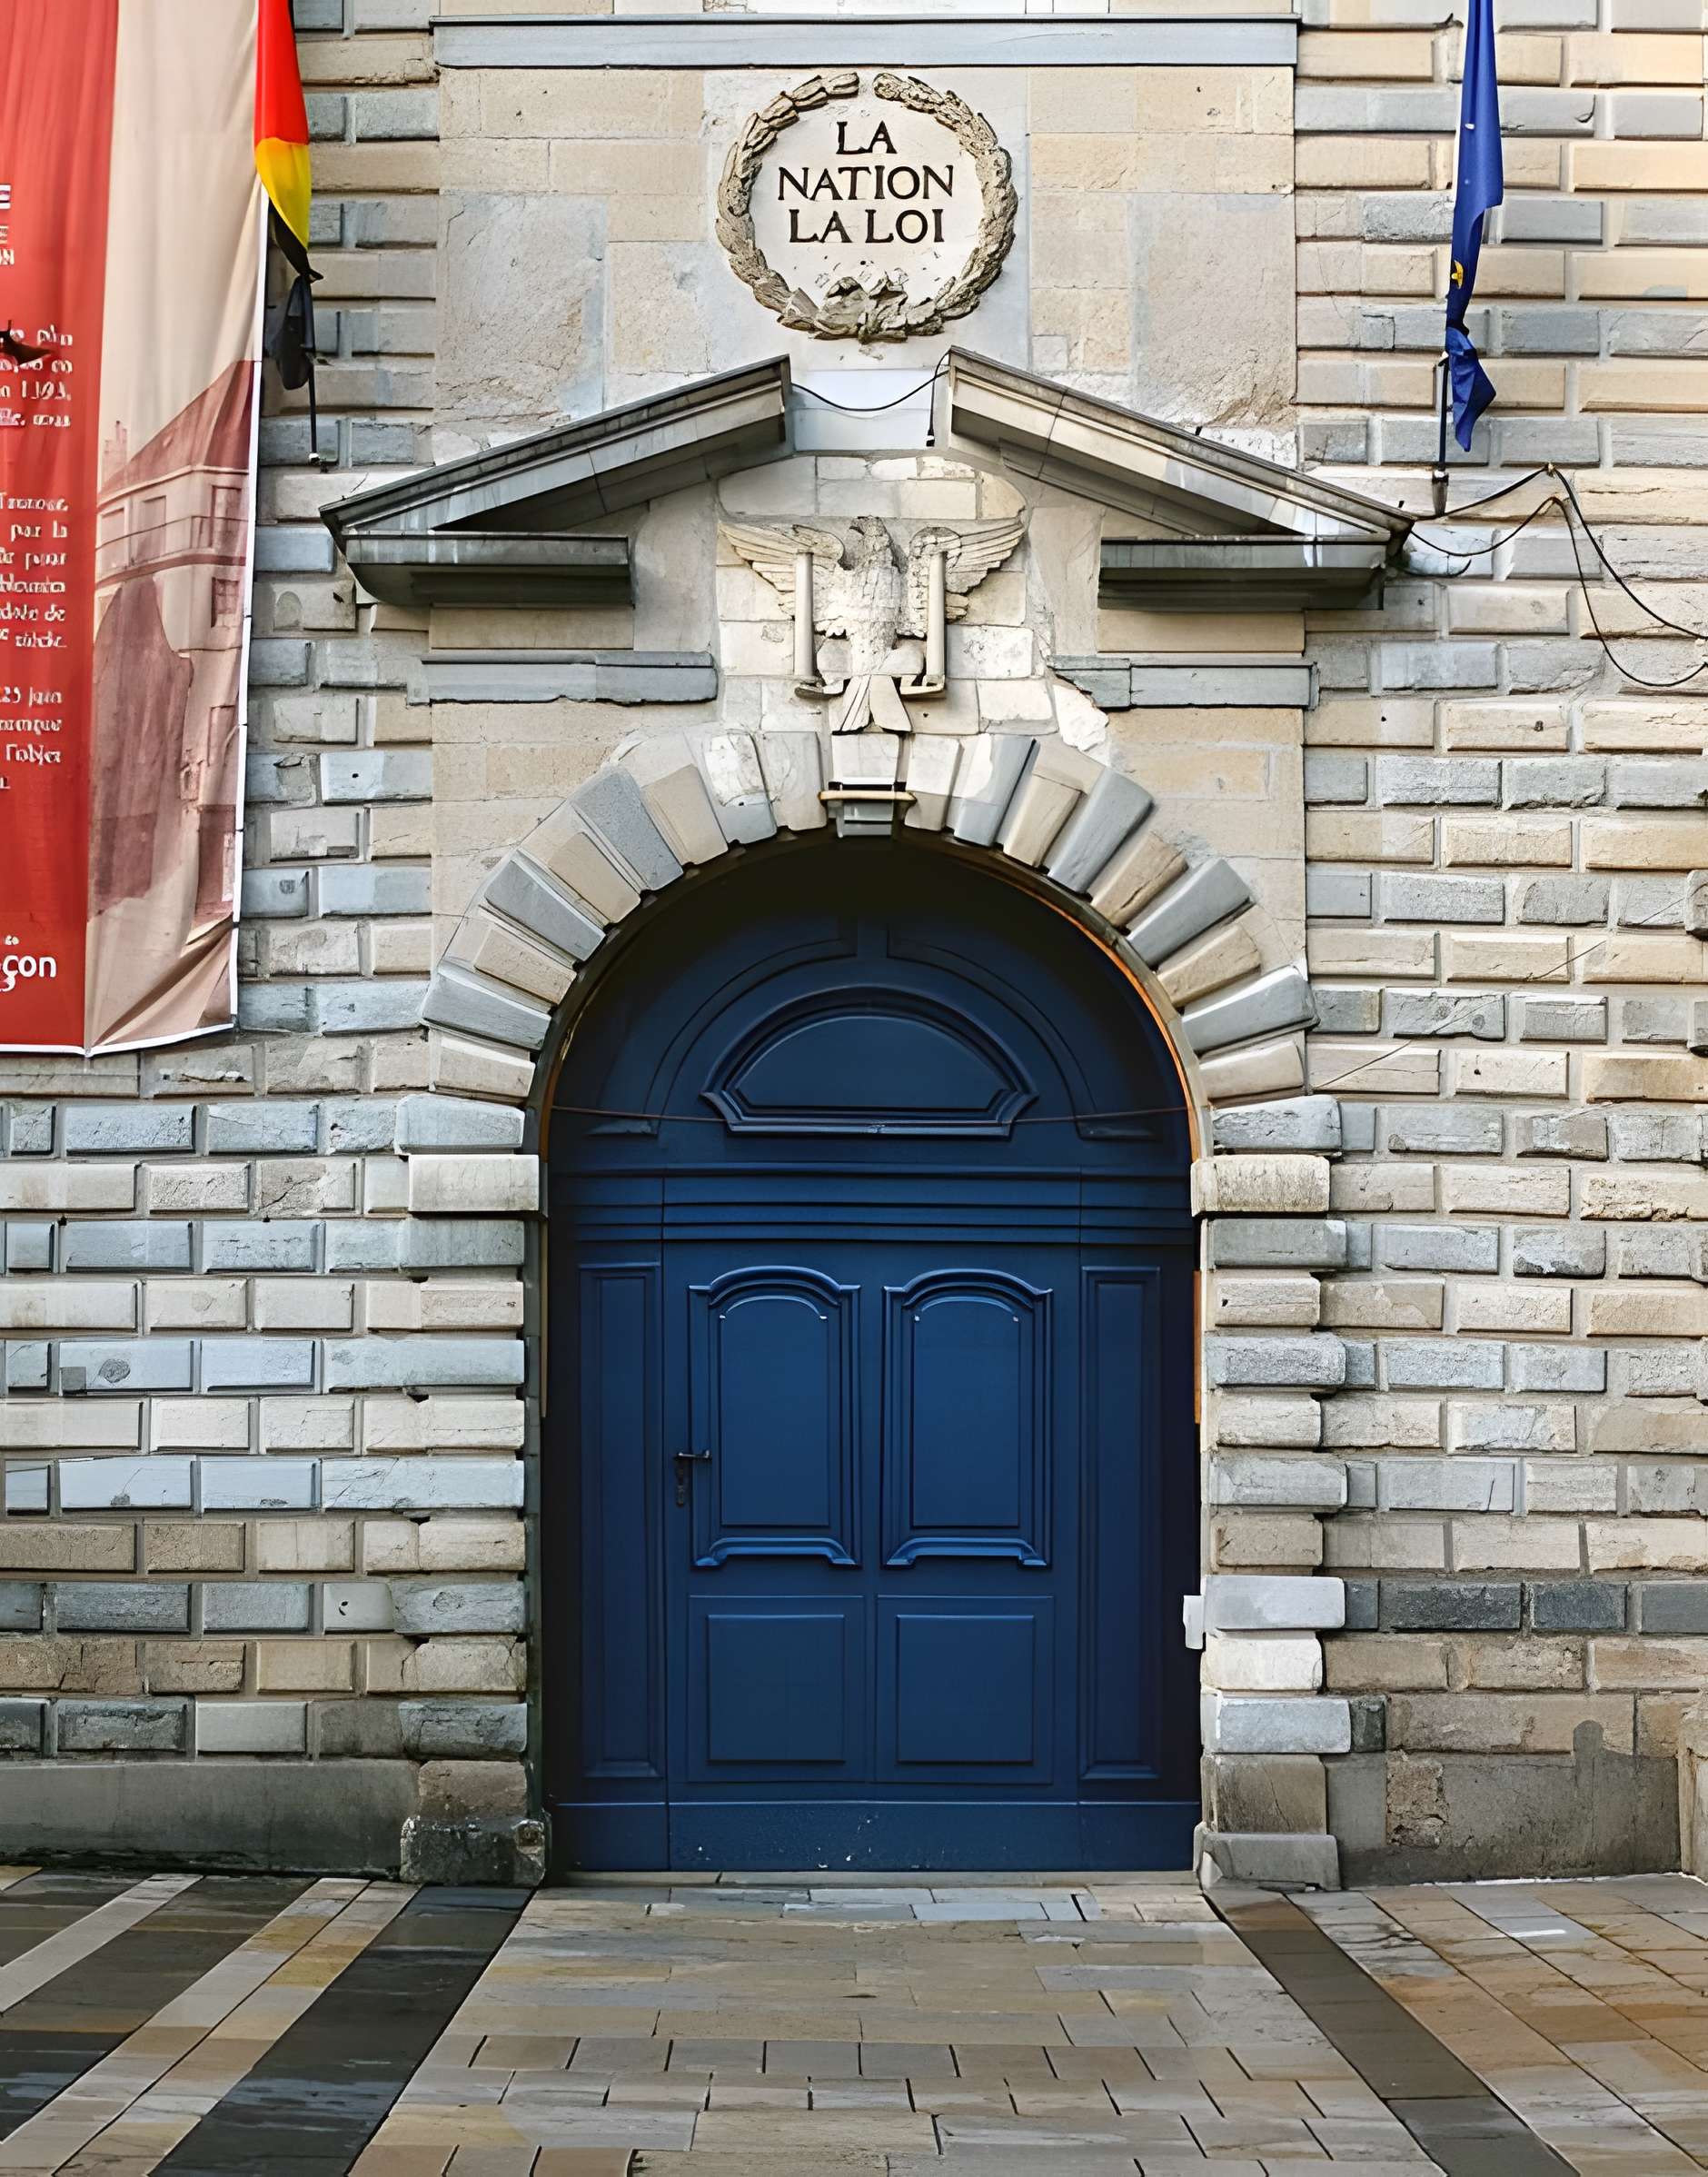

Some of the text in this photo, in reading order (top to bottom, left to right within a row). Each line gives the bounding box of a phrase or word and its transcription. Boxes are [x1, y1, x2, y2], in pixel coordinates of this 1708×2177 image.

[835, 120, 898, 155] LA
[778, 164, 954, 201] NATION
[788, 208, 944, 244] LA LOI
[0, 954, 57, 992] çon
